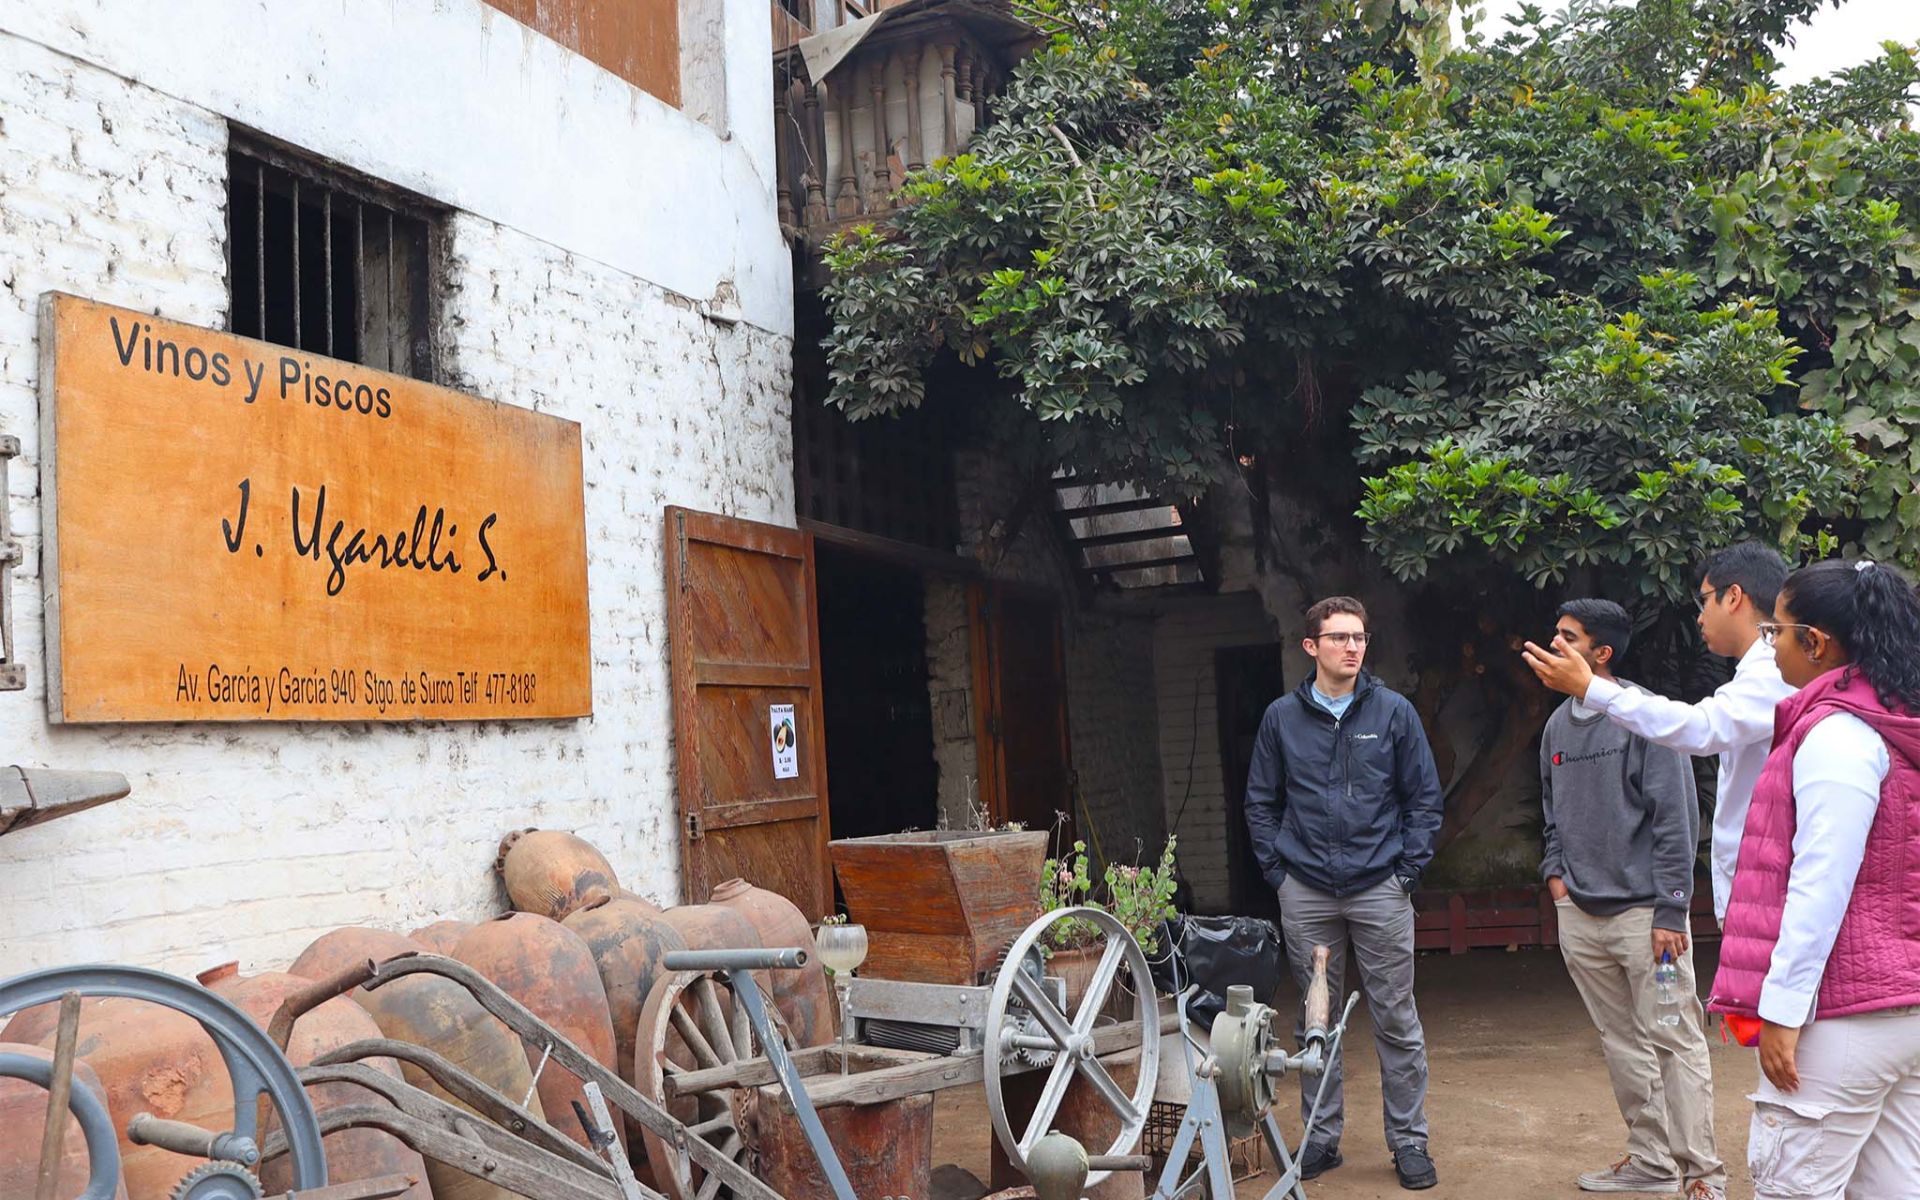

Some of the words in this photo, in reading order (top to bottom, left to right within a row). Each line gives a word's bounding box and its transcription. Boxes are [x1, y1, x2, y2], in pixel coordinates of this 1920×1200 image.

[110, 316, 231, 386] Vinos
[244, 359, 264, 404] y
[280, 356, 392, 418] Piscos
[222, 478, 263, 557] J.
[292, 484, 461, 596] Ugarelli
[477, 512, 507, 582] S.
[176, 663, 201, 702] Av.
[207, 663, 260, 704] García
[265, 676, 275, 713] y
[279, 666, 327, 704] García
[331, 668, 356, 704] 940
[365, 669, 397, 714] Stgo.
[401, 671, 416, 704] de
[420, 671, 454, 704] Surco
[457, 671, 478, 704] Telf
[485, 673, 537, 704] 477-8188
[1551, 747, 1625, 766] Champion
